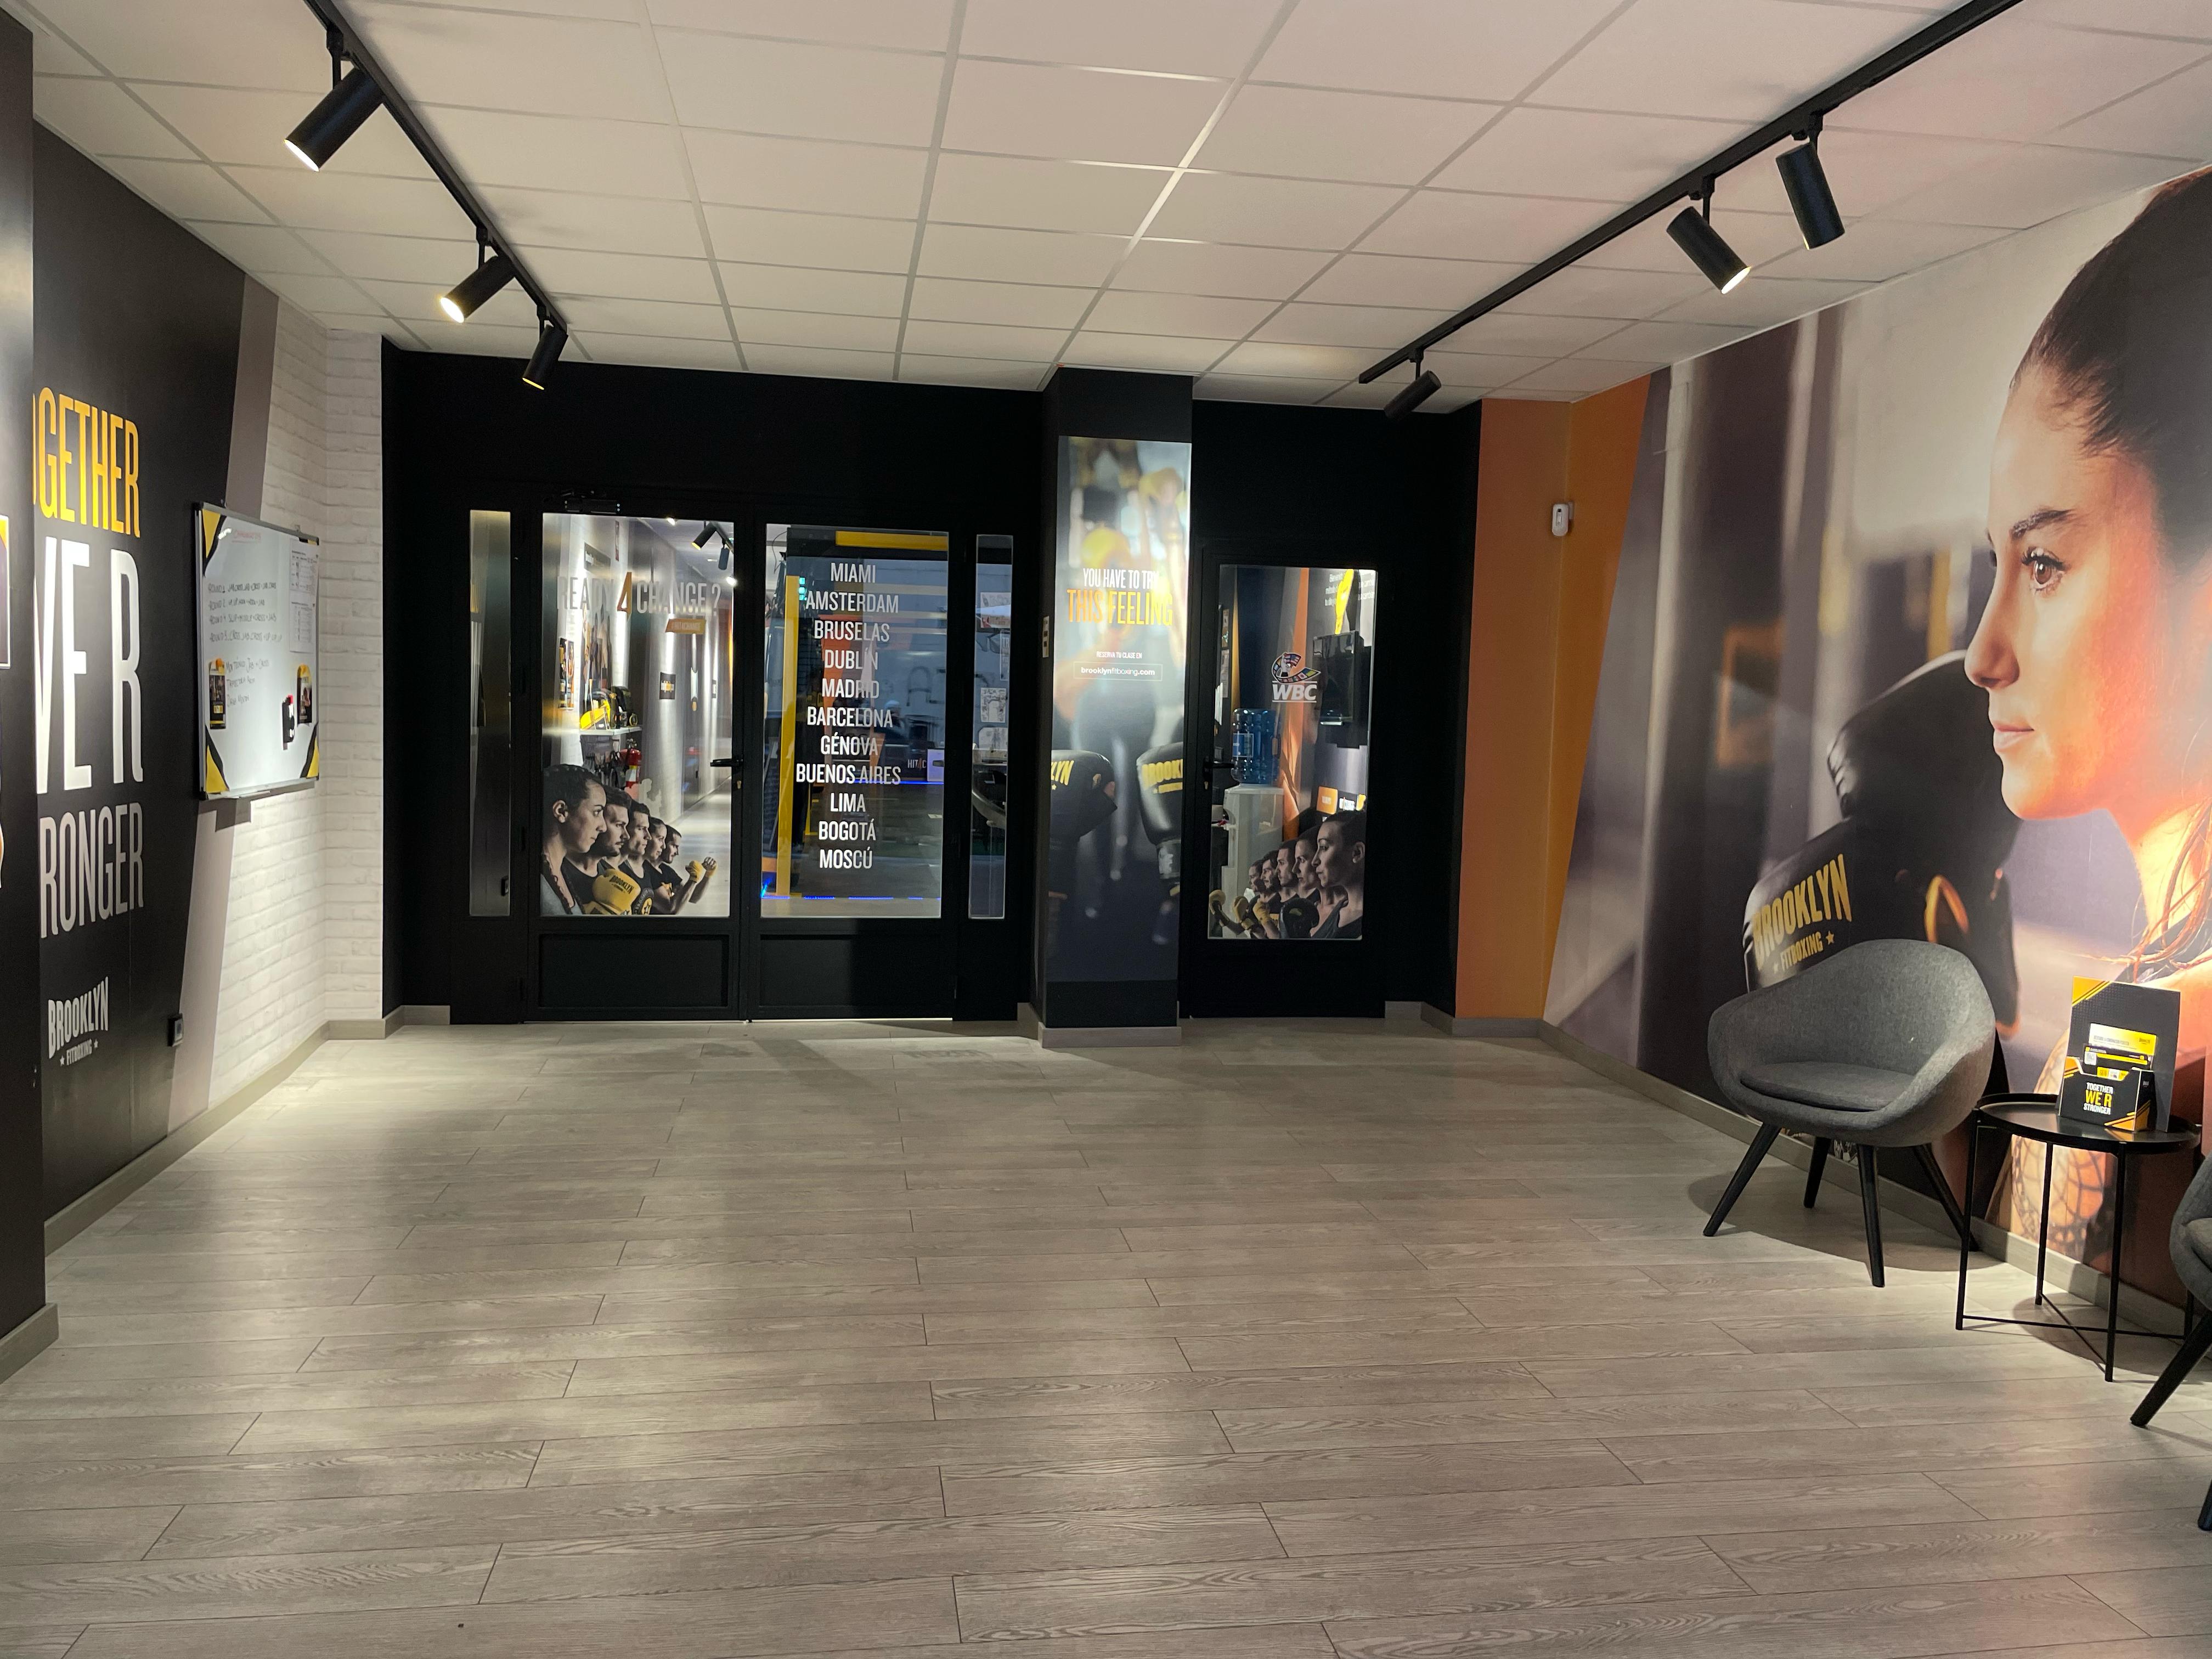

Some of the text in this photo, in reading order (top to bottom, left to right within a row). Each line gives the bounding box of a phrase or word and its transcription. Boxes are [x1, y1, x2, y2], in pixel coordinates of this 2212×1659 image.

[33, 387, 140, 538] GETHER
[831, 562, 876, 583] MIAMI
[1083, 568, 1101, 588] YOU
[1103, 569, 1126, 589] HAVE
[1128, 570, 1139, 589] TO
[805, 590, 899, 613] AMSTERDAM
[1066, 589, 1173, 626] THIS FEELING
[814, 620, 890, 642] BRUSELAS
[111, 549, 143, 783] R
[825, 647, 878, 670] DUBLÍN
[1081, 667, 1155, 676] brooklynfitboxing.com
[822, 678, 880, 698] MADRID
[1272, 684, 1317, 700] WBC
[807, 706, 893, 728] BARCELONA
[821, 732, 878, 755] GÉNOVA
[796, 763, 901, 785] BUENOS AIRES
[830, 792, 866, 812] LIMA
[819, 818, 876, 841] BOGOTÁ
[820, 847, 872, 869] MOSCÚ
[609, 875, 635, 895] BROOKLYN
[1752, 854, 1852, 971] BROOKLYN
[1780, 931, 1824, 970] FITBOXING
[48, 976, 109, 1059] BROOKLYN
[66, 1039, 93, 1066] FITBOXING
[2085, 1090, 2112, 1108] WE R
[2086, 1082, 2114, 1094] TOGETHER
[2083, 1102, 2111, 1115] STRONGER
